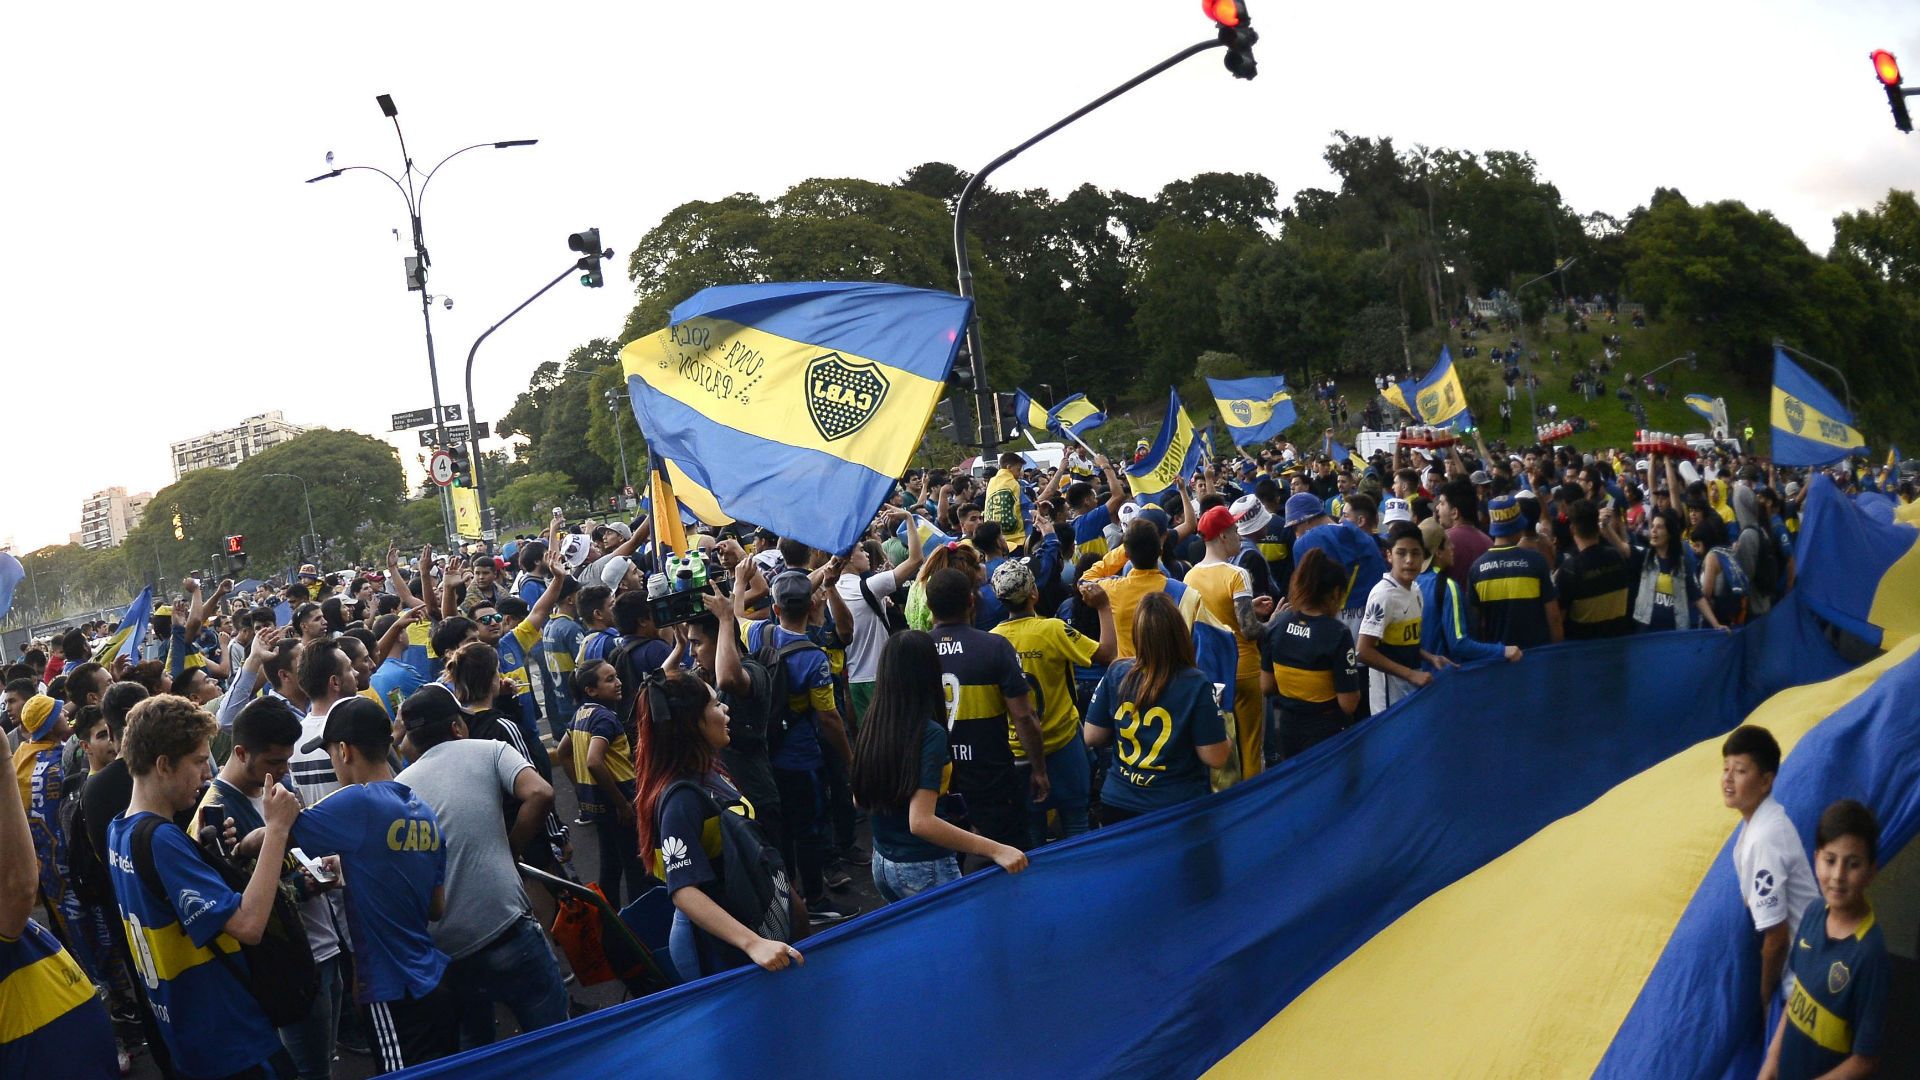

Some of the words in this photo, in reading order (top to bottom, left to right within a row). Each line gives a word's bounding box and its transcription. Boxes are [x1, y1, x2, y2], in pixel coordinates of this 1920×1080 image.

[438, 458, 447, 472] 4
[992, 494, 1002, 522] CAB
[1499, 559, 1529, 568] Francés
[1286, 622, 1311, 639] BBVA
[1018, 649, 1043, 660] ncés
[941, 672, 960, 732] 9
[1114, 701, 1172, 771] 32
[951, 744, 972, 761] TRI
[386, 818, 441, 851] CABJ
